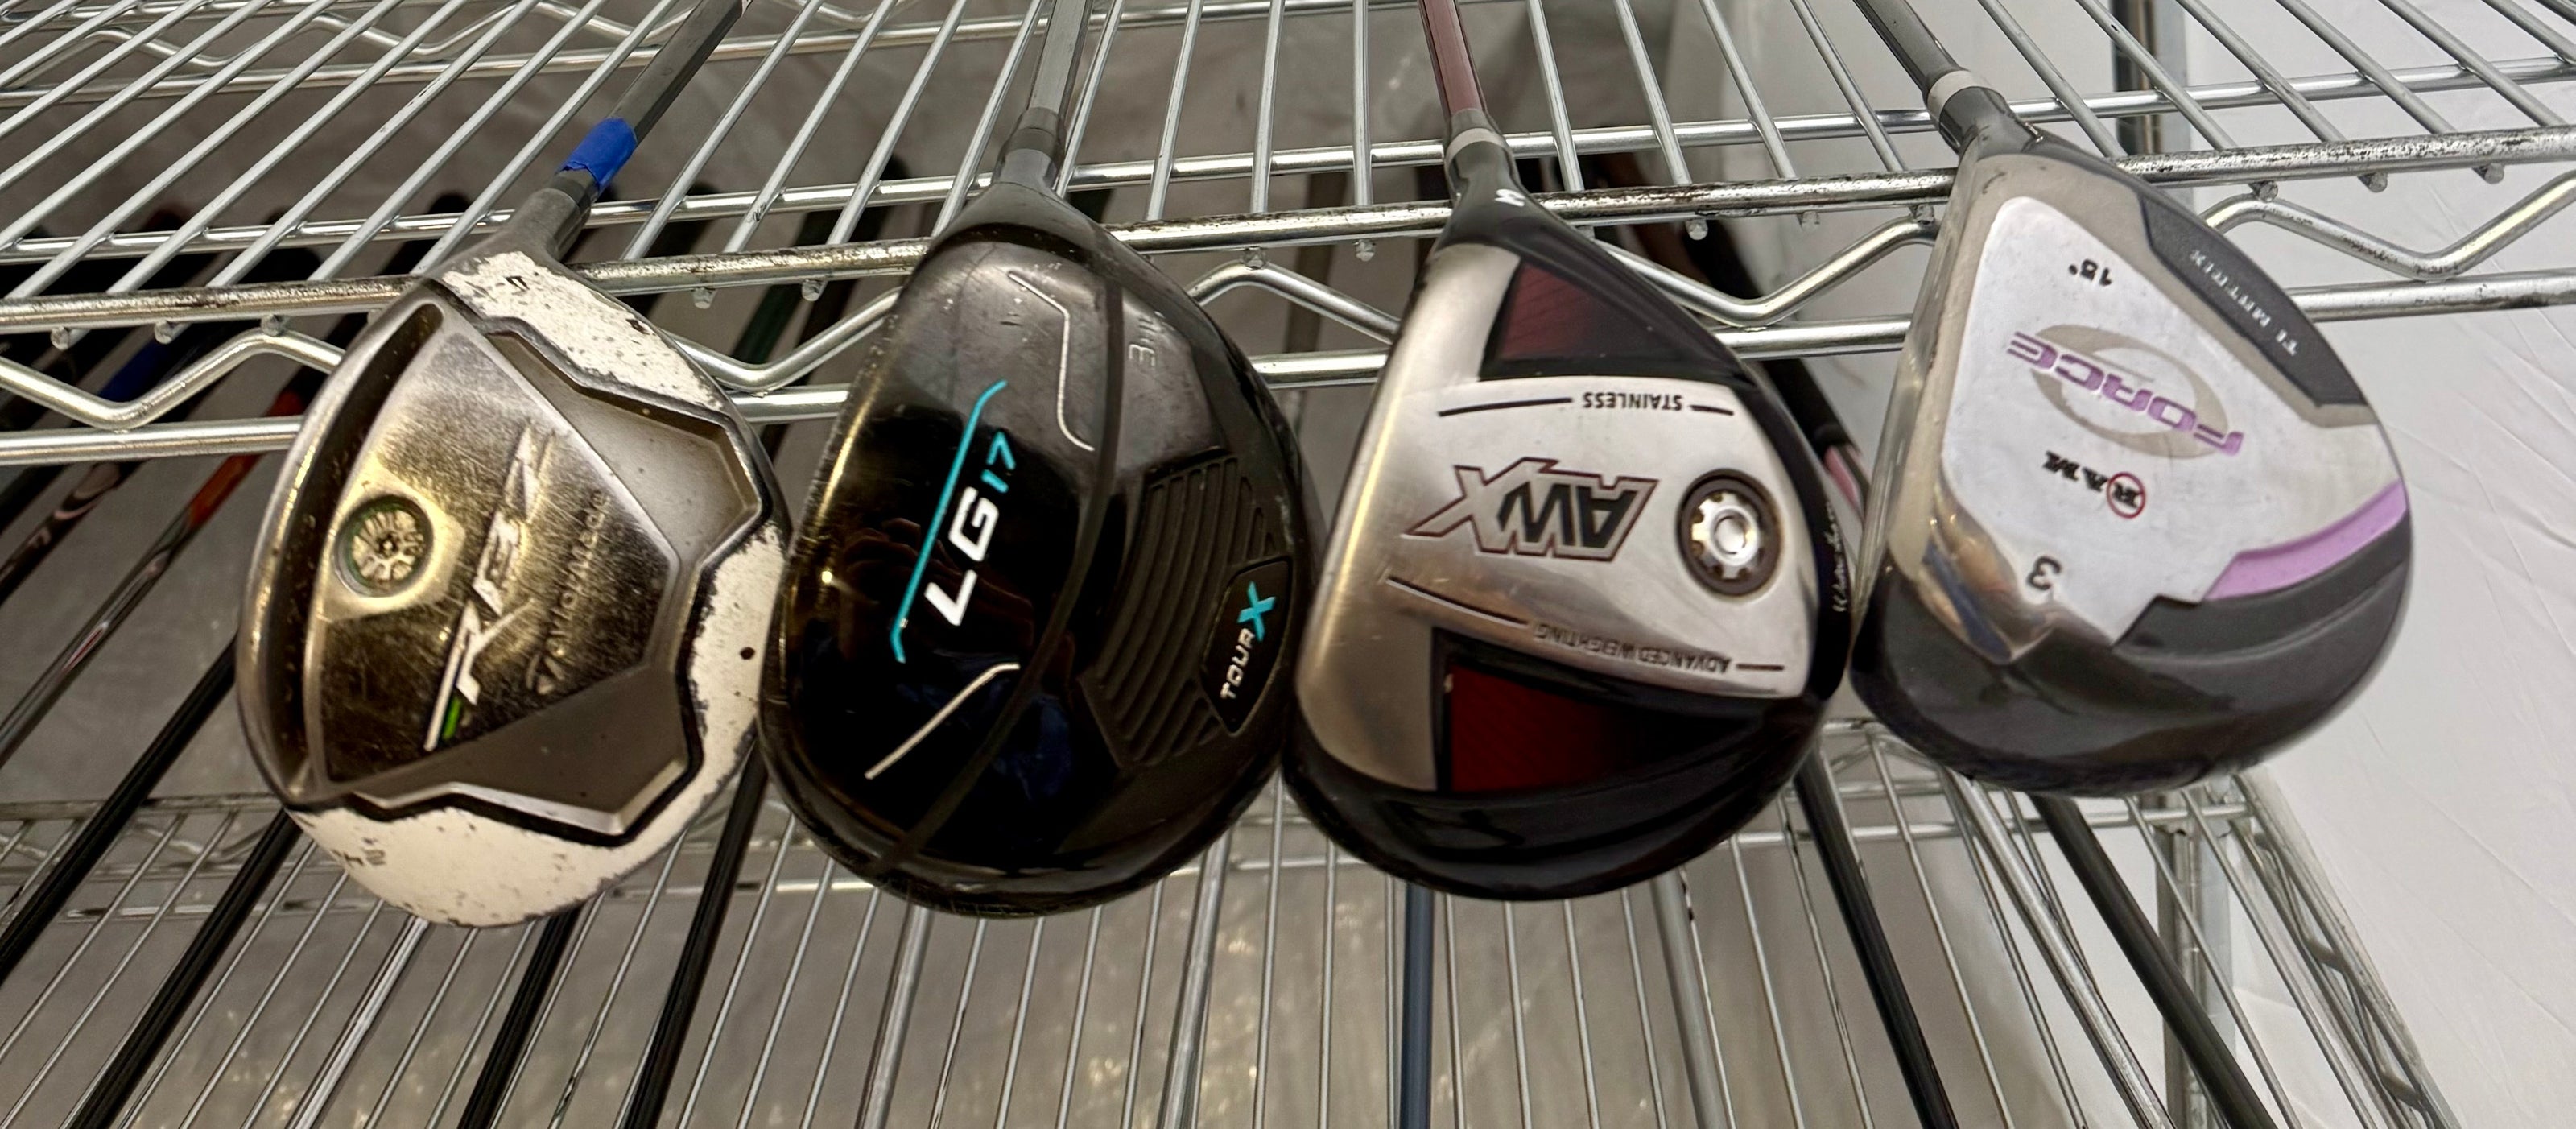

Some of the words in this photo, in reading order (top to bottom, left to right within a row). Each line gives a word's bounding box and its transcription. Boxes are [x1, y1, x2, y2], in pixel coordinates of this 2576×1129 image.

[1583, 391, 1683, 411] STAINLESS
[2006, 331, 2244, 457] FORCE
[2042, 449, 2147, 519] RAM
[1402, 456, 1661, 563] AWX
[2025, 555, 2063, 592] 3
[1532, 622, 1632, 660] WEIGHTING
[1634, 645, 1732, 675] ADVANCED
